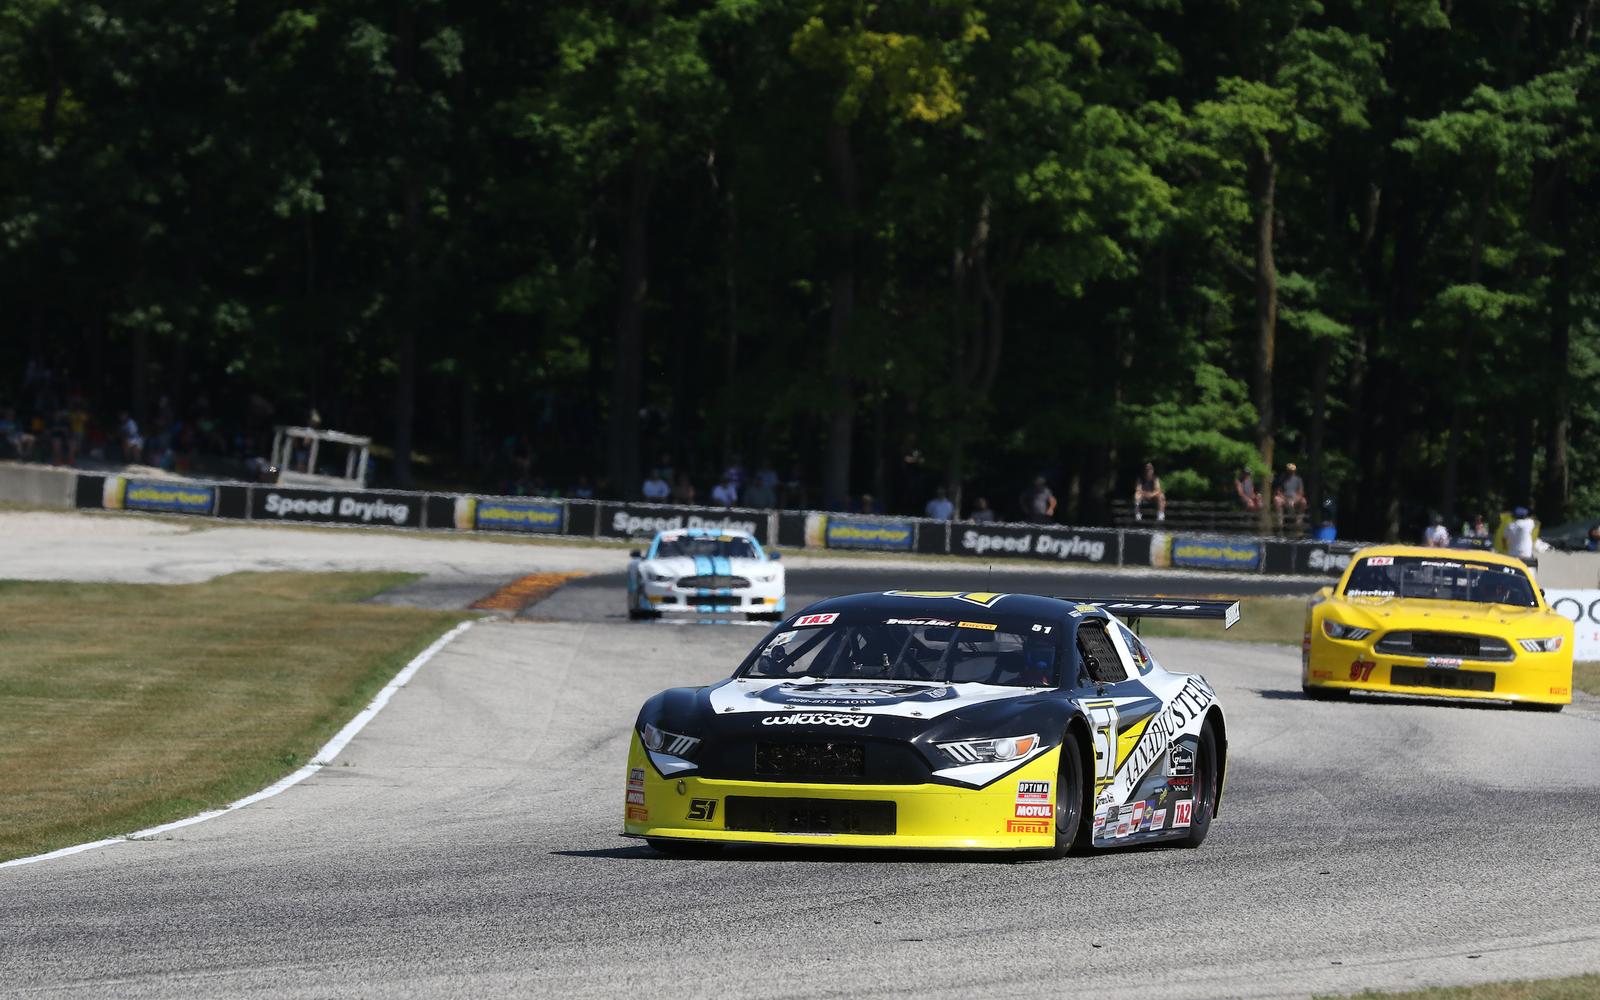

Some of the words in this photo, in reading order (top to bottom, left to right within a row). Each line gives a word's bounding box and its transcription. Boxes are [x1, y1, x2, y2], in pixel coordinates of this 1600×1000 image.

[265, 493, 334, 516] Speed
[339, 497, 409, 524] Drying
[613, 512, 683, 534] Speed
[962, 530, 1031, 553] Speed
[1036, 535, 1105, 561] Drying
[1309, 549, 1351, 571] Spe
[801, 615, 833, 625] TA2
[1031, 624, 1052, 634] 51
[1350, 661, 1376, 682] 97
[1019, 783, 1048, 793] OPTIMA
[686, 799, 718, 821] 51
[1016, 805, 1052, 817] MOTUL
[1175, 803, 1191, 824] TA2
[1007, 820, 1049, 833] PIRELLI
